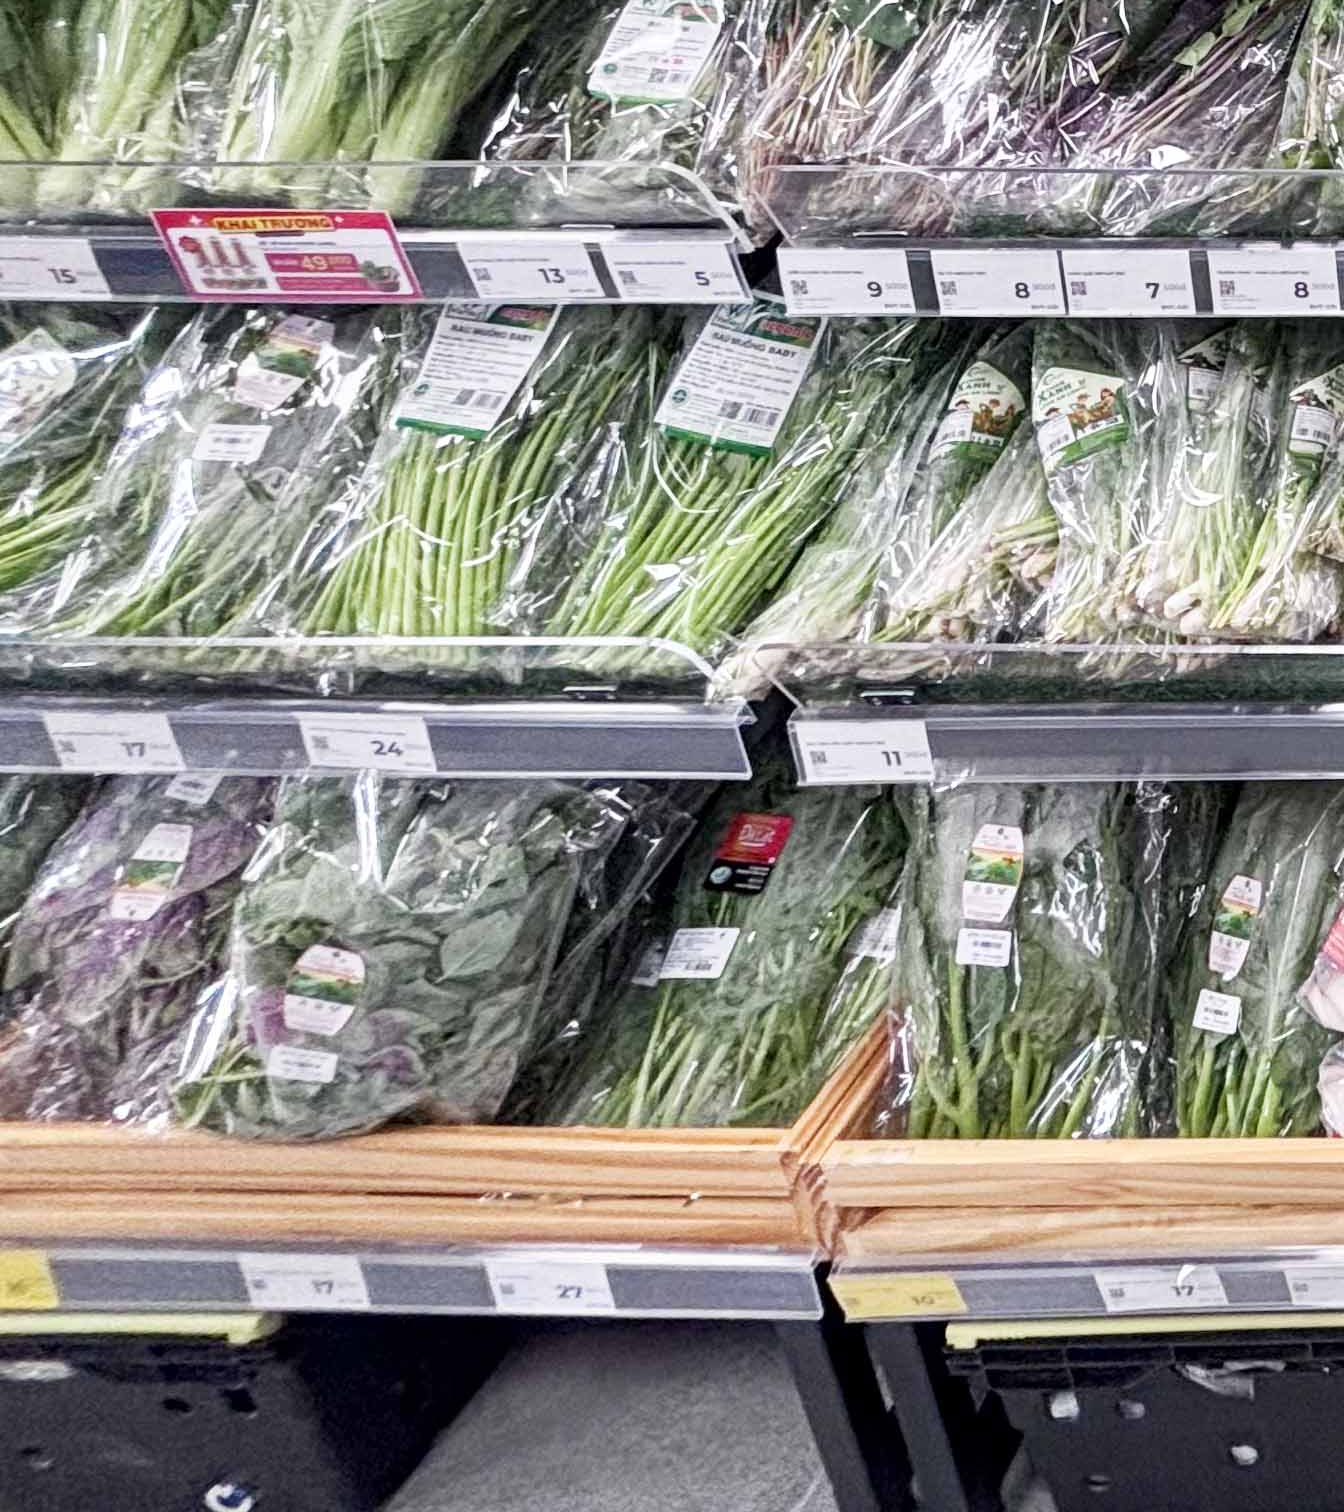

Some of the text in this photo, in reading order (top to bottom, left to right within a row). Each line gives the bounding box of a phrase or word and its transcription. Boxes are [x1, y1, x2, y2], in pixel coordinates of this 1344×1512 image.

[537, 268, 565, 284] 13
[694, 271, 710, 286] 5
[867, 281, 883, 298] 9
[1014, 282, 1030, 299] 8
[1145, 282, 1160, 299] 7
[1294, 281, 1310, 299] 8
[881, 751, 902, 766] 11
